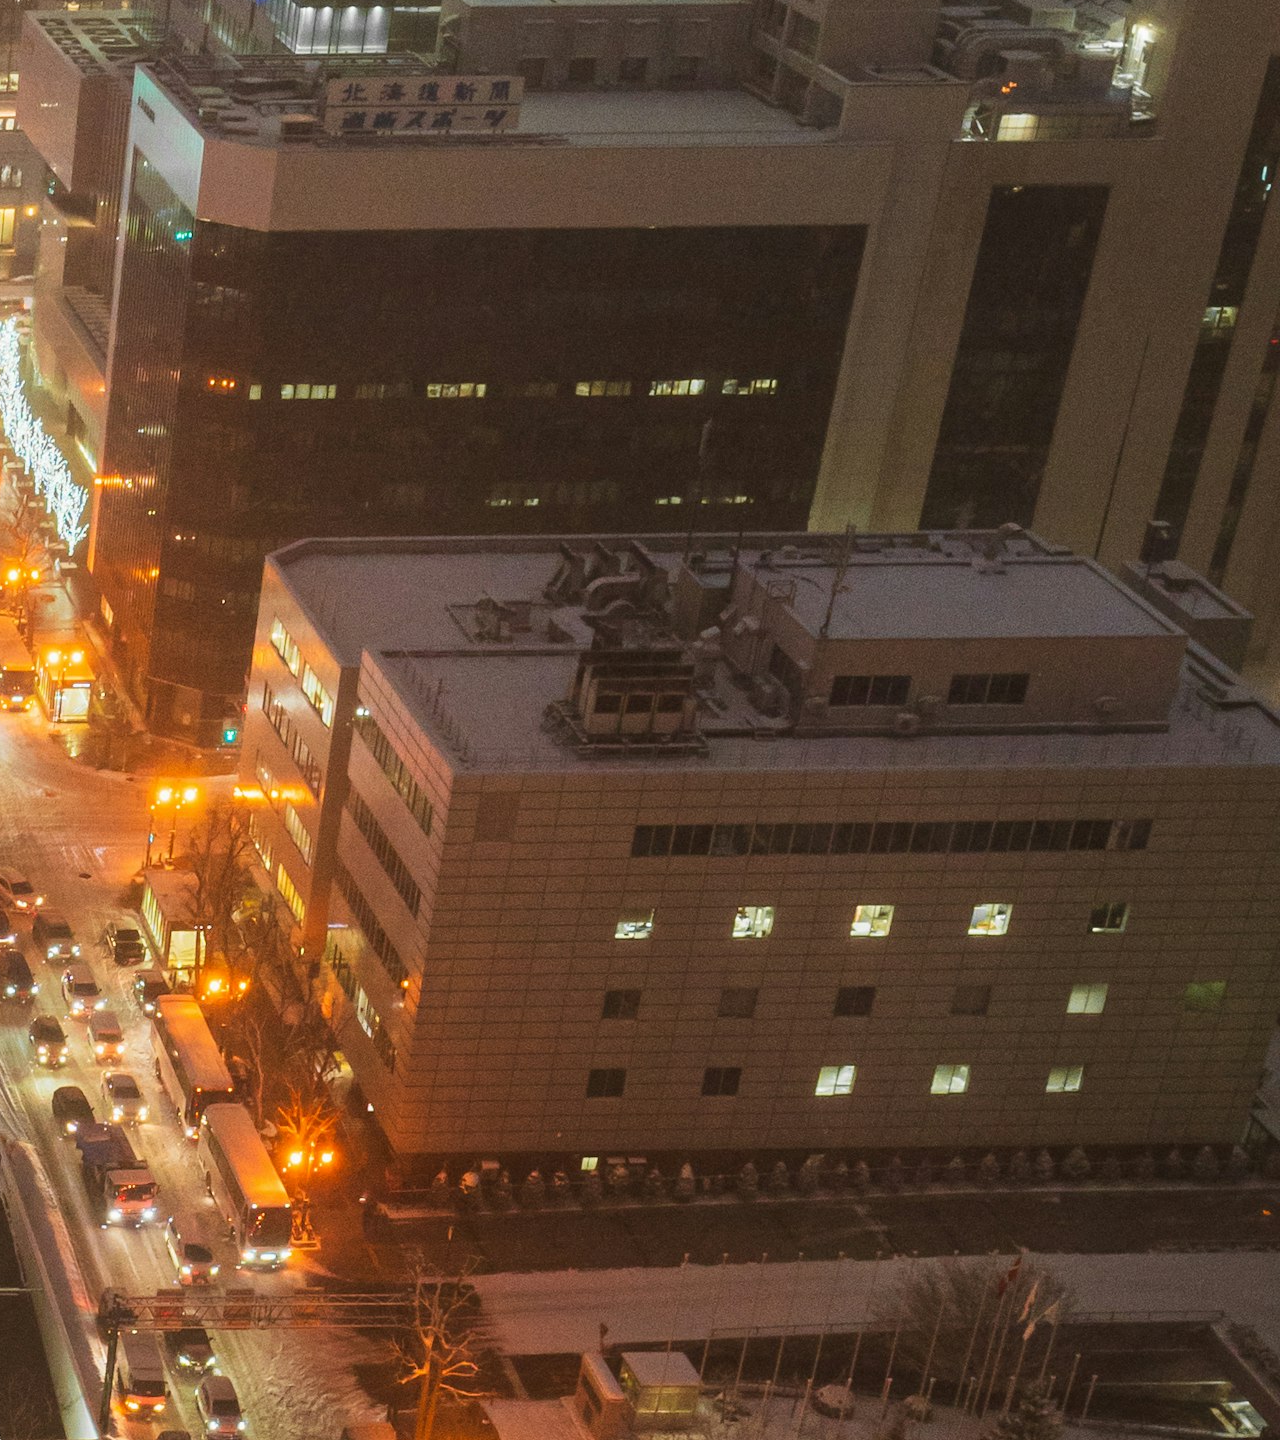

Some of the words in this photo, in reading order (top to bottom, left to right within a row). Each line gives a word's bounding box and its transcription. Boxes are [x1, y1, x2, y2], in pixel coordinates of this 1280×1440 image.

[342, 80, 511, 103] 北海道新聞
